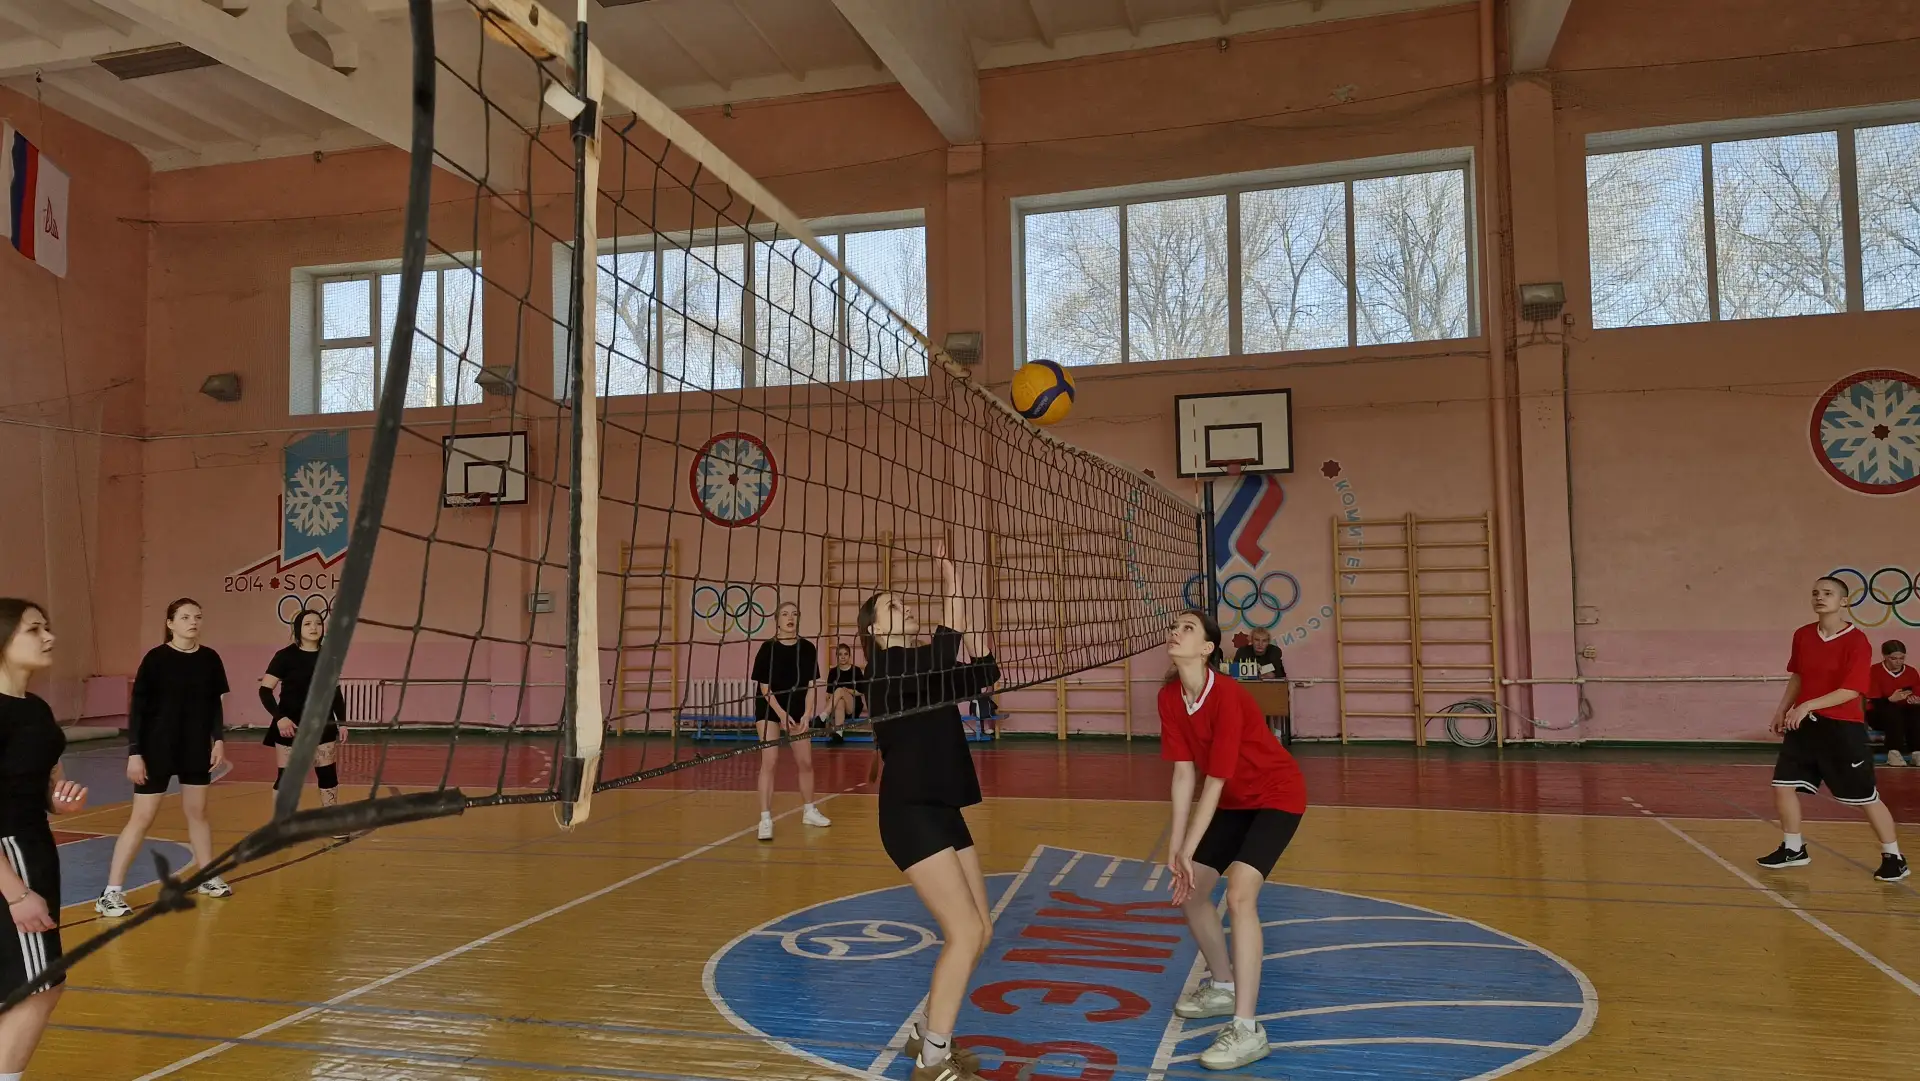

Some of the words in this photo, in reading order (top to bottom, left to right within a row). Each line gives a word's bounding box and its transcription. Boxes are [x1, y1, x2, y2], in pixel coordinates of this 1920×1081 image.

[224, 575, 264, 592] 2014
[284, 573, 341, 591] SOCH
[1273, 593, 1344, 646] ОССИ
[1240, 664, 1256, 676] 01
